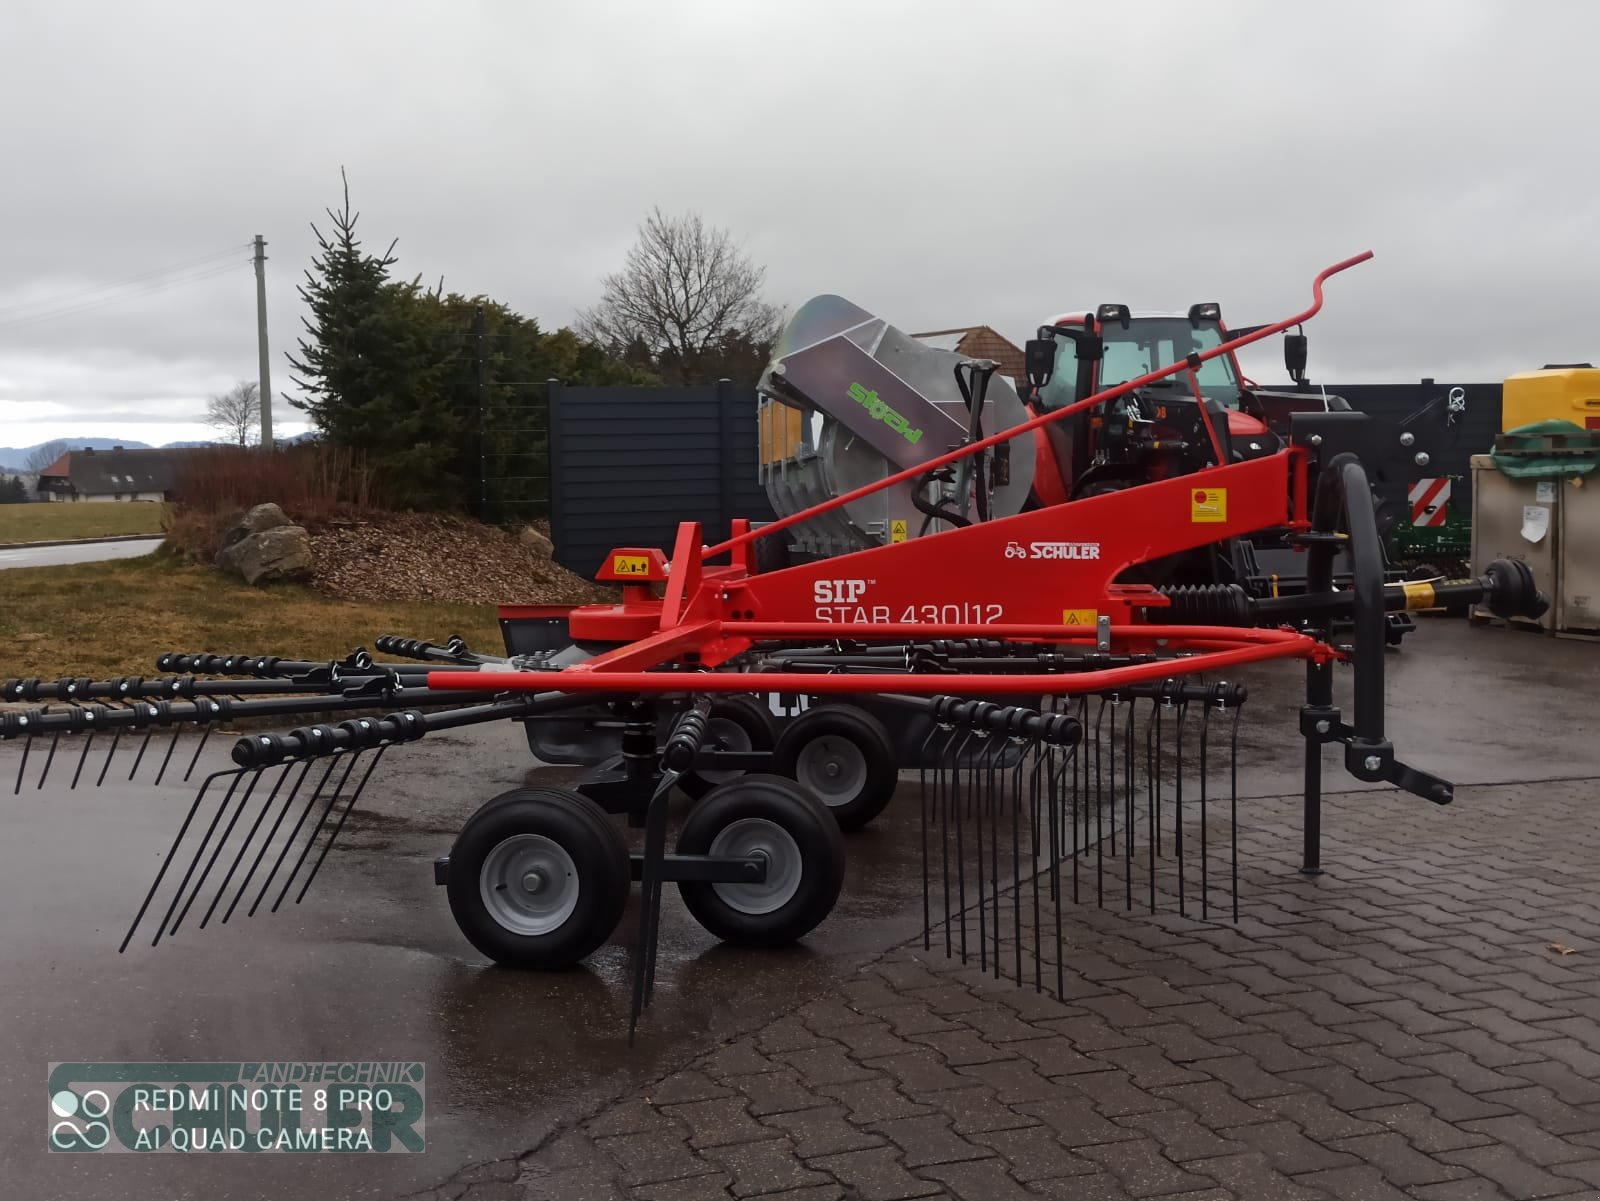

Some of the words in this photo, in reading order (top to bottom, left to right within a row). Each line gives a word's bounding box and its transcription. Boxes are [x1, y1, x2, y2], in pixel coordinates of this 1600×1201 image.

[1030, 542, 1100, 559] SCHULER
[814, 579, 866, 603] SIP
[815, 606, 890, 624] STAR
